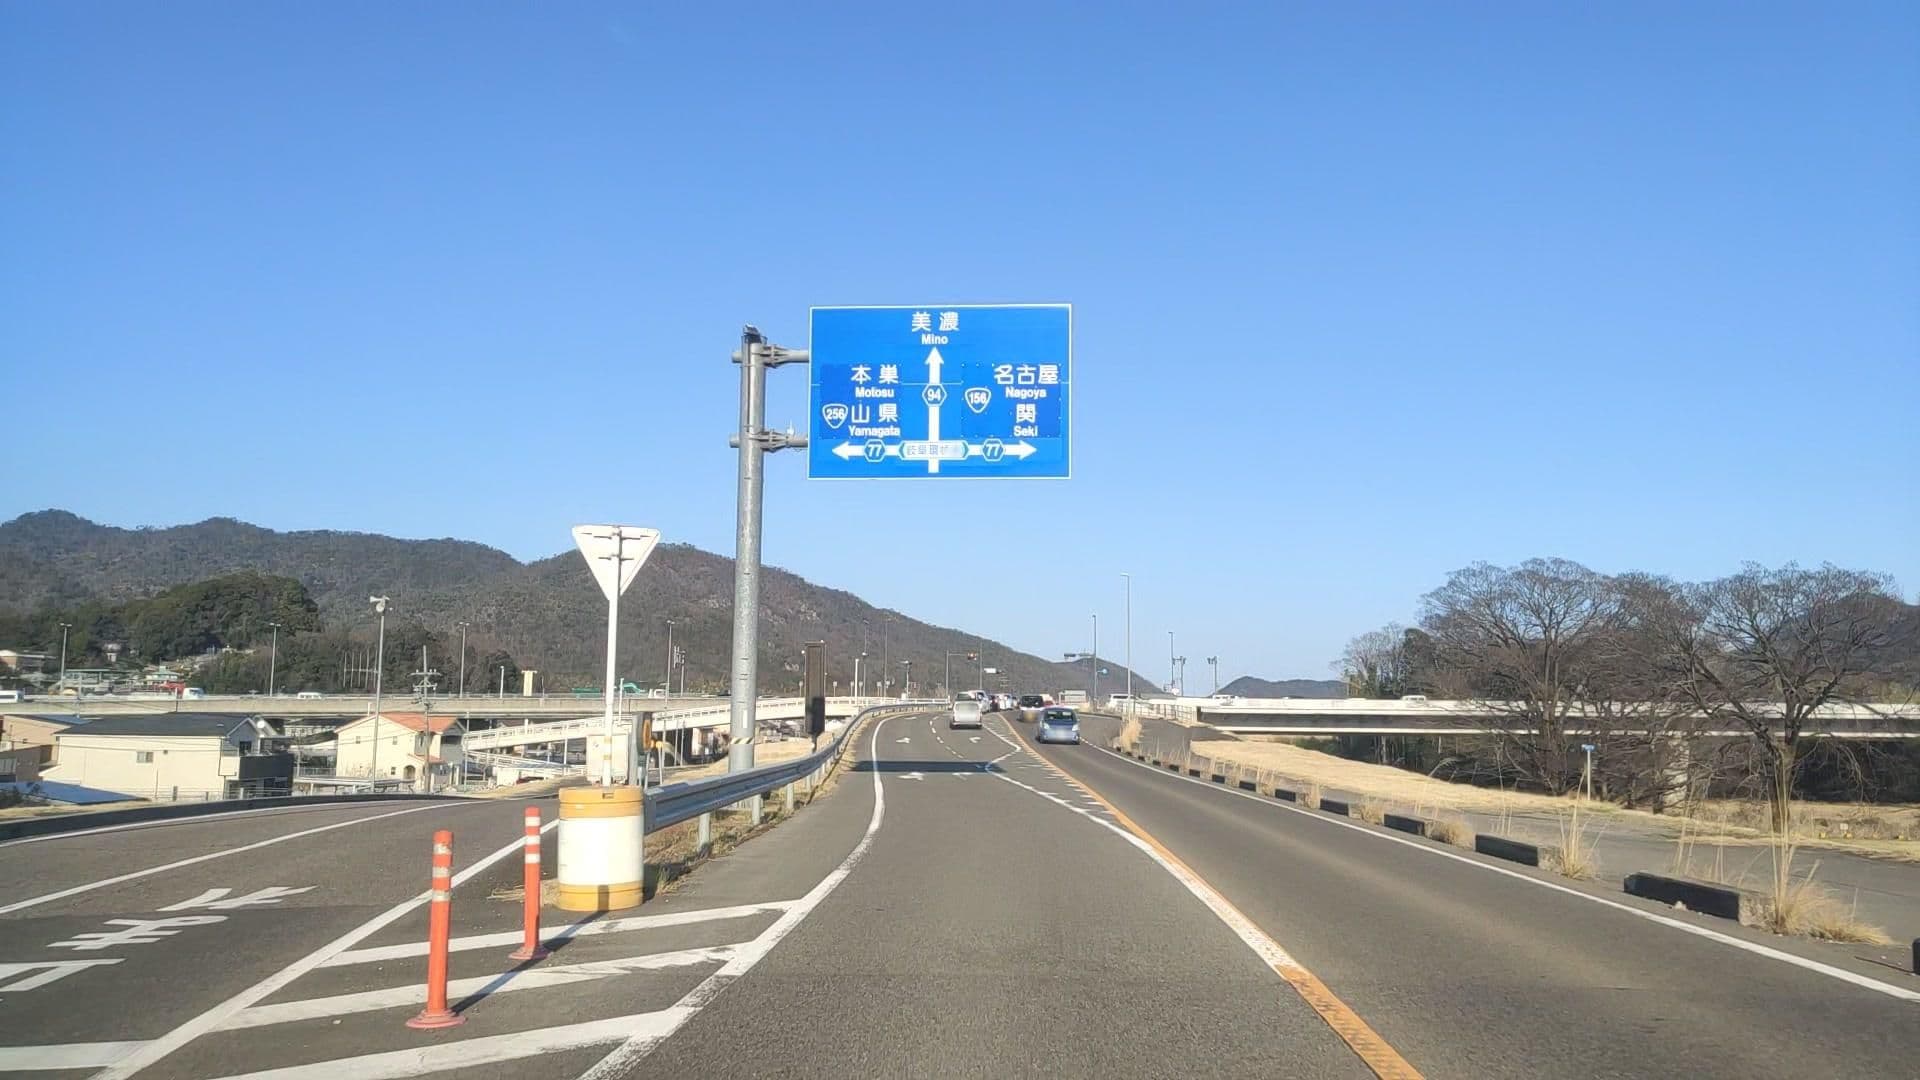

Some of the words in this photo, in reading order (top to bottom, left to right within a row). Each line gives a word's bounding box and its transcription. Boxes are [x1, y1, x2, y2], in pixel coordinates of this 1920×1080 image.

[911, 311, 959, 332] 美濃
[921, 333, 949, 345] Mino
[850, 364, 899, 385] 本巣
[993, 364, 1059, 385] 名古屋
[855, 386, 895, 398] Motosu
[926, 389, 942, 402] 94
[969, 392, 987, 405] 156
[1005, 386, 1047, 400] Nagoya
[825, 407, 845, 421] 256
[851, 402, 899, 424] 山県
[1016, 403, 1037, 424] 関
[848, 425, 901, 438] Yamagata
[1013, 425, 1038, 438] Seki
[867, 443, 882, 457] 77
[985, 442, 1001, 457] 77
